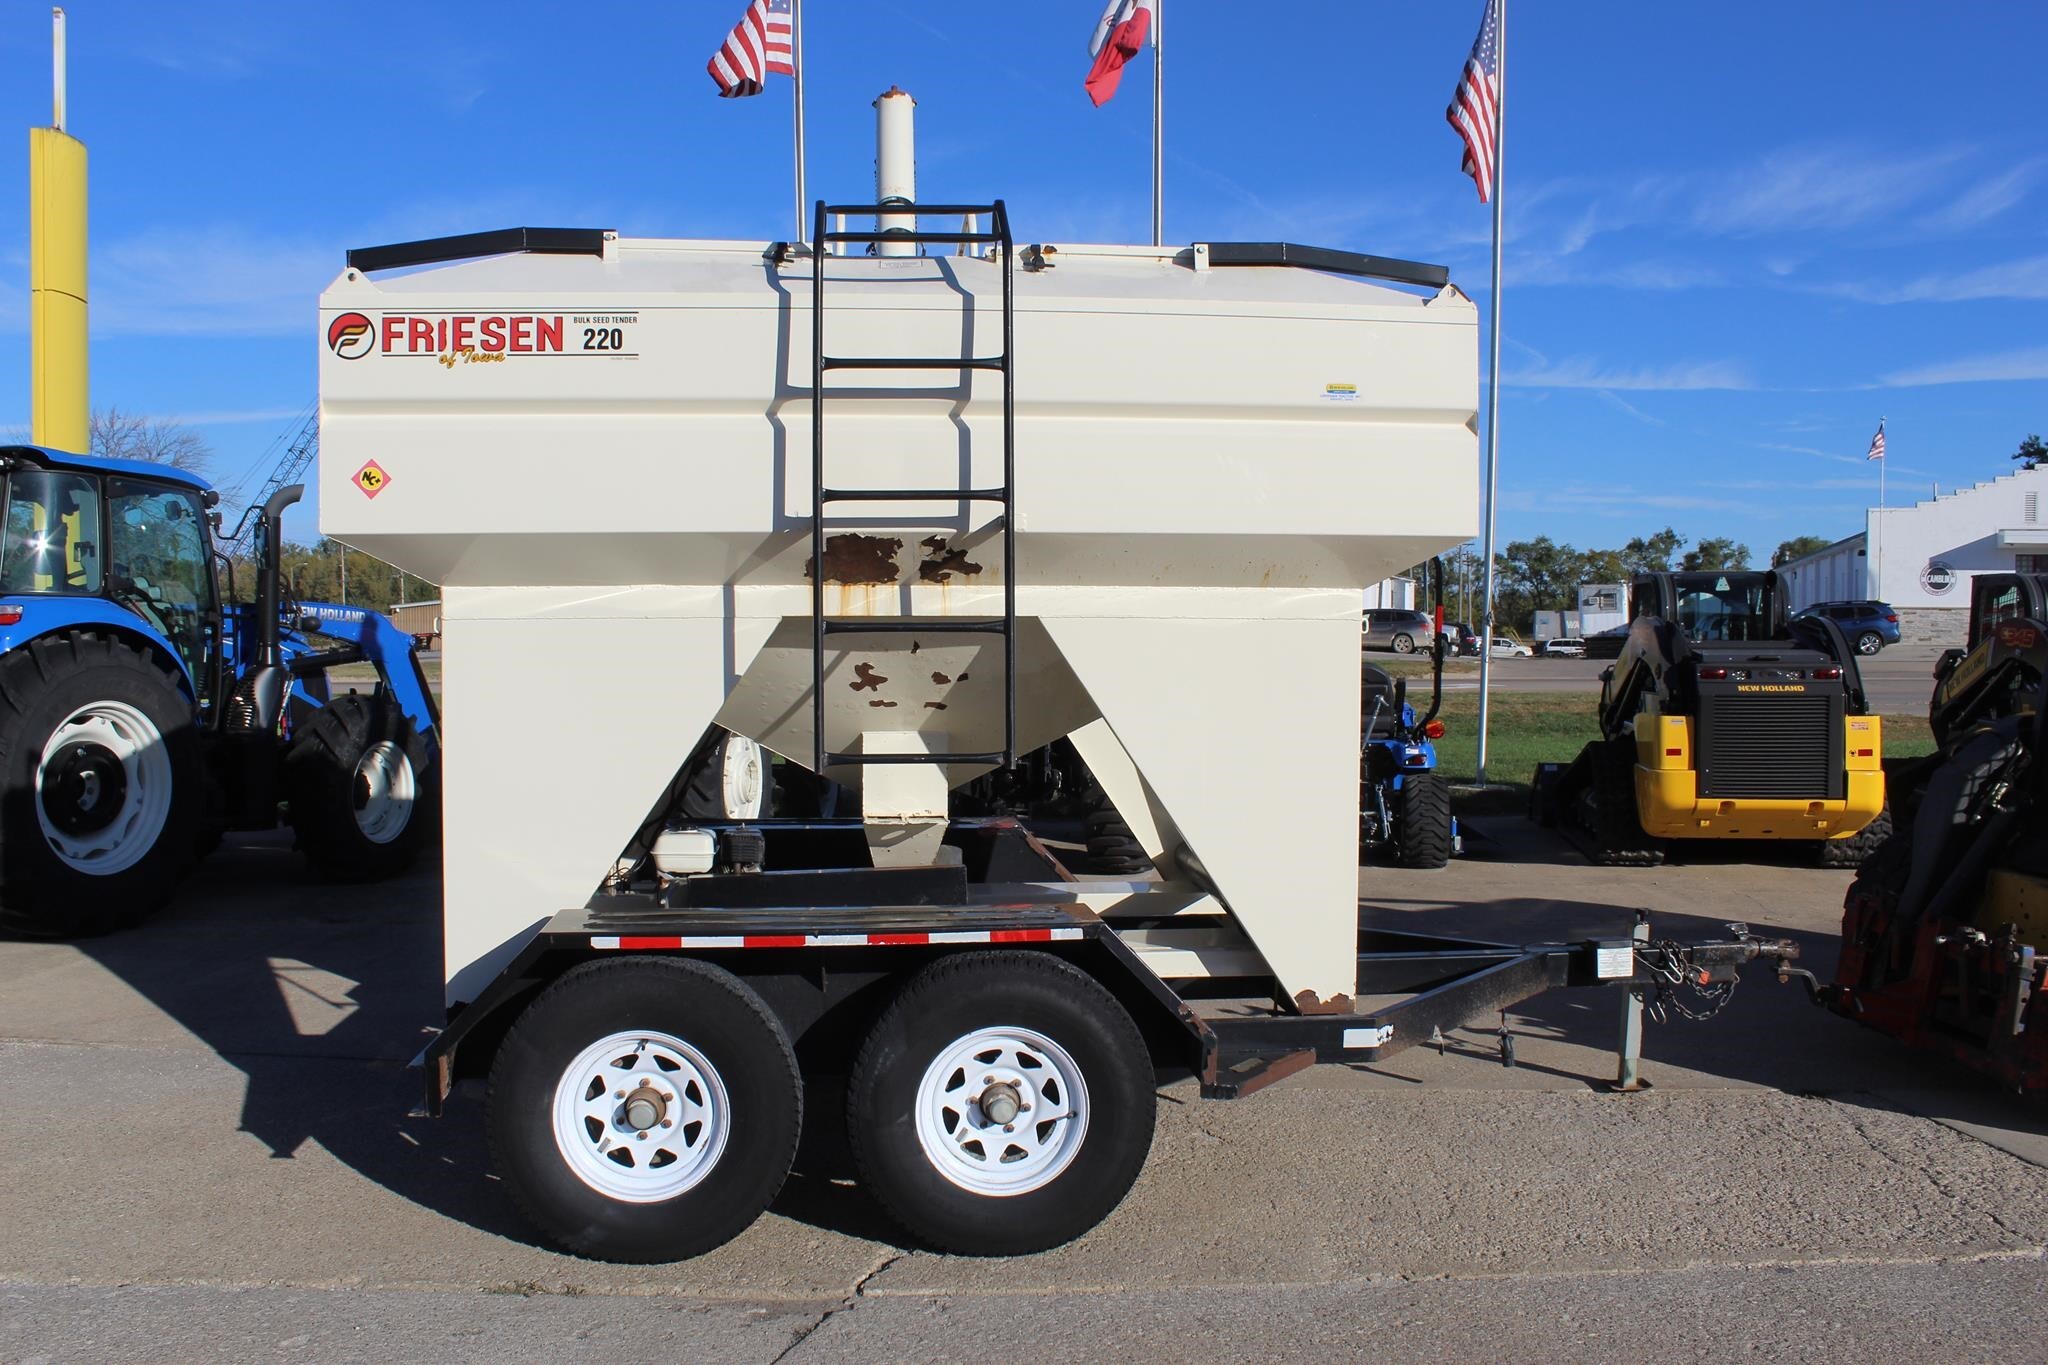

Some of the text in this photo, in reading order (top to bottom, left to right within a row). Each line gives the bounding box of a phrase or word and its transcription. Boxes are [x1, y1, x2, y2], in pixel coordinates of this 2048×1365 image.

[573, 316, 638, 324] BULK SEED TENDER
[381, 316, 563, 352] FRIESEN
[583, 327, 623, 350] 220
[438, 347, 505, 369] of Iowa
[300, 605, 366, 623] EW HOLLAND
